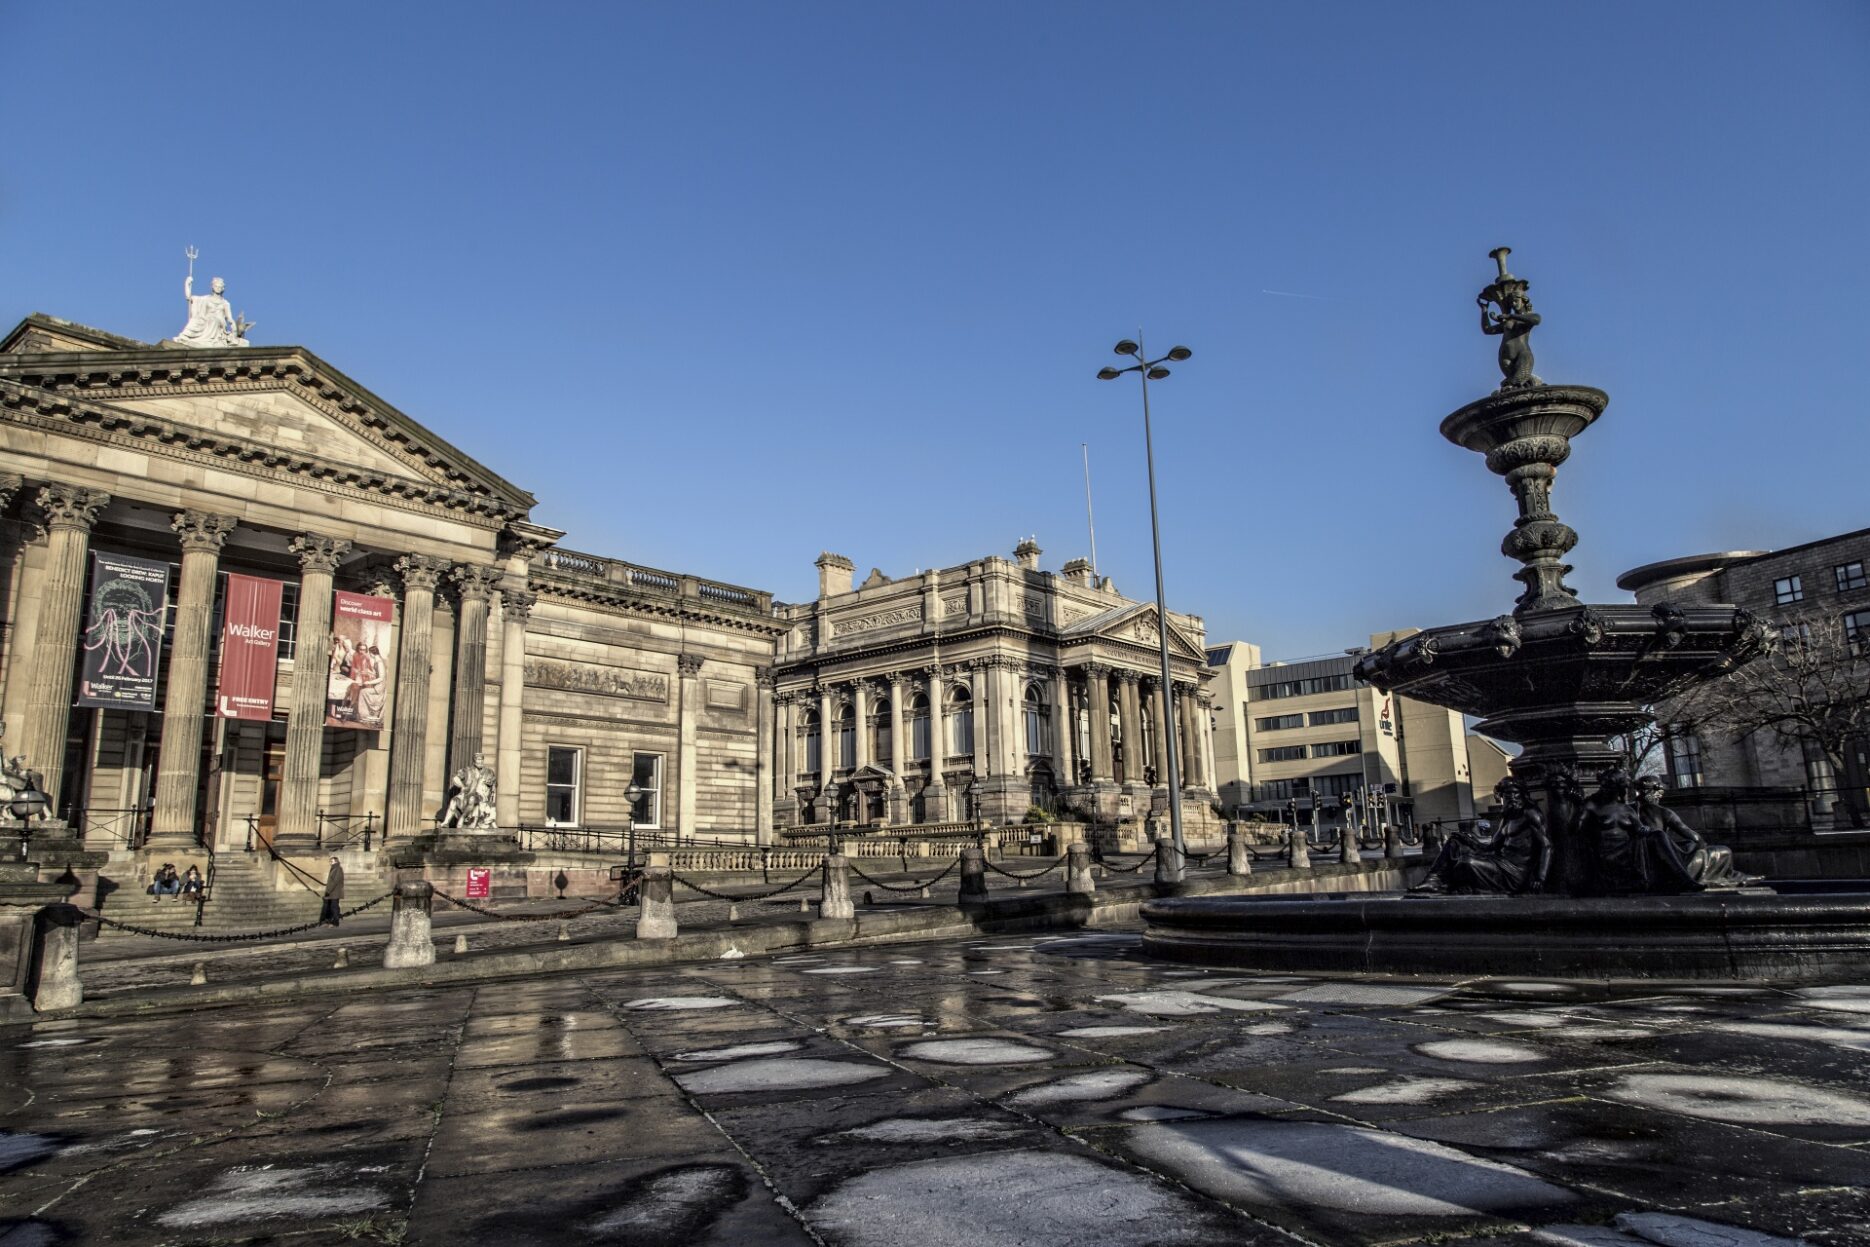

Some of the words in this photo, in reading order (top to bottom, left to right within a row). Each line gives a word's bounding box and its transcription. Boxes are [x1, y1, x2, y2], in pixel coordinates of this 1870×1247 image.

[340, 598, 362, 607] Discover
[357, 608, 372, 616] class
[229, 622, 275, 639] Walker
[253, 639, 271, 647] Gallery
[90, 682, 114, 691] Walker
[248, 697, 269, 705] ENTRY
